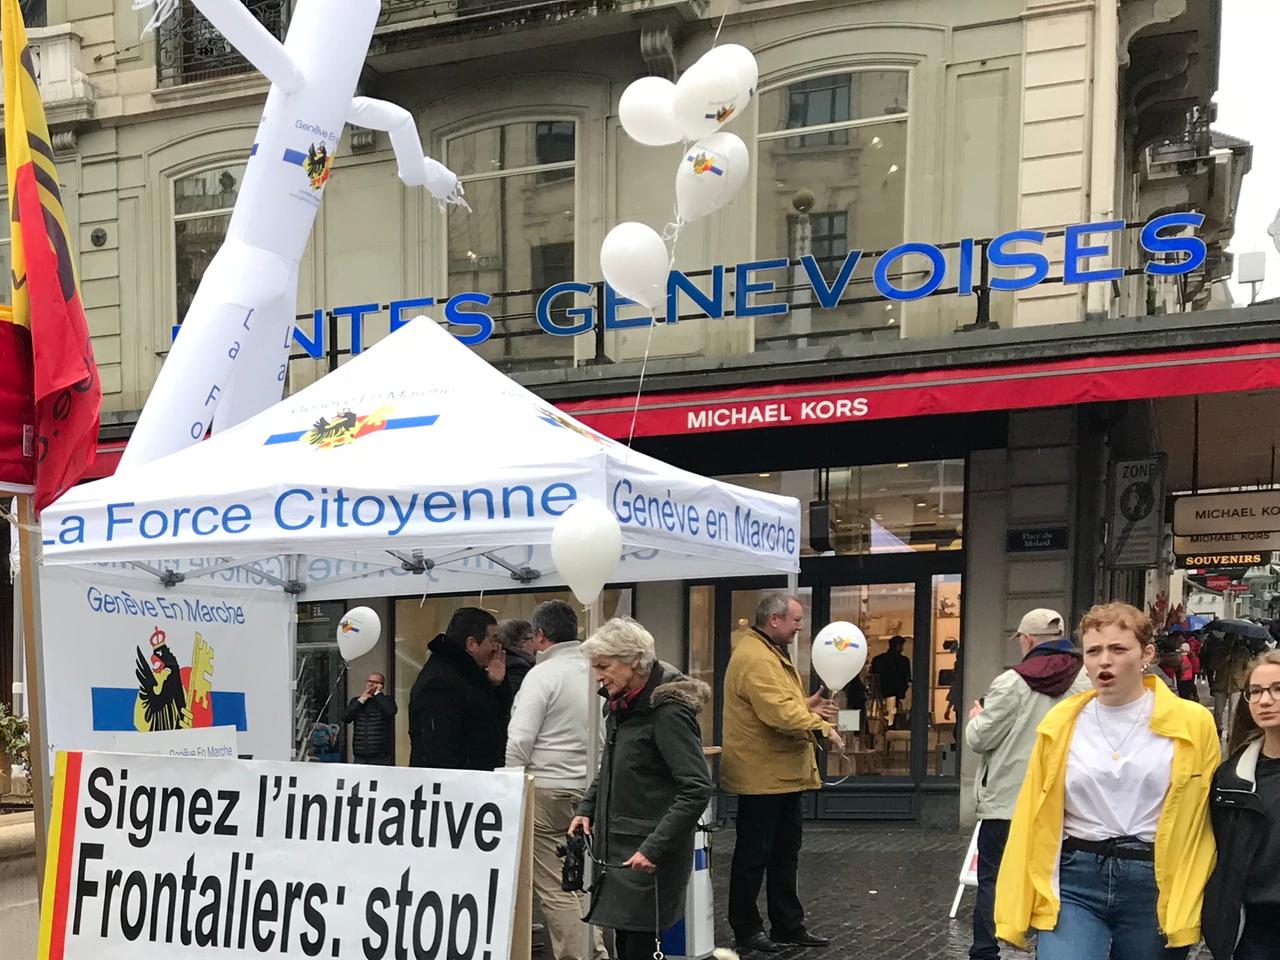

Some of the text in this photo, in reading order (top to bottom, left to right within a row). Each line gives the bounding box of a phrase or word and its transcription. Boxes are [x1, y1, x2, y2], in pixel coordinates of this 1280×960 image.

[536, 212, 1207, 336] GENEVOISES
[687, 398, 869, 429] MICHAEL KORS
[106, 501, 253, 542] Force
[273, 481, 578, 536] Citoyenne
[705, 509, 729, 542] en
[734, 504, 796, 555] Marche
[1194, 506, 1257, 520] MICHAEL
[1240, 532, 1271, 541] KORS
[1185, 554, 1261, 566] SOUVENIRS
[86, 586, 246, 624] Genève En Marche
[84, 766, 504, 853] Signez l’initiative
[72, 842, 347, 958] Frontaliers:
